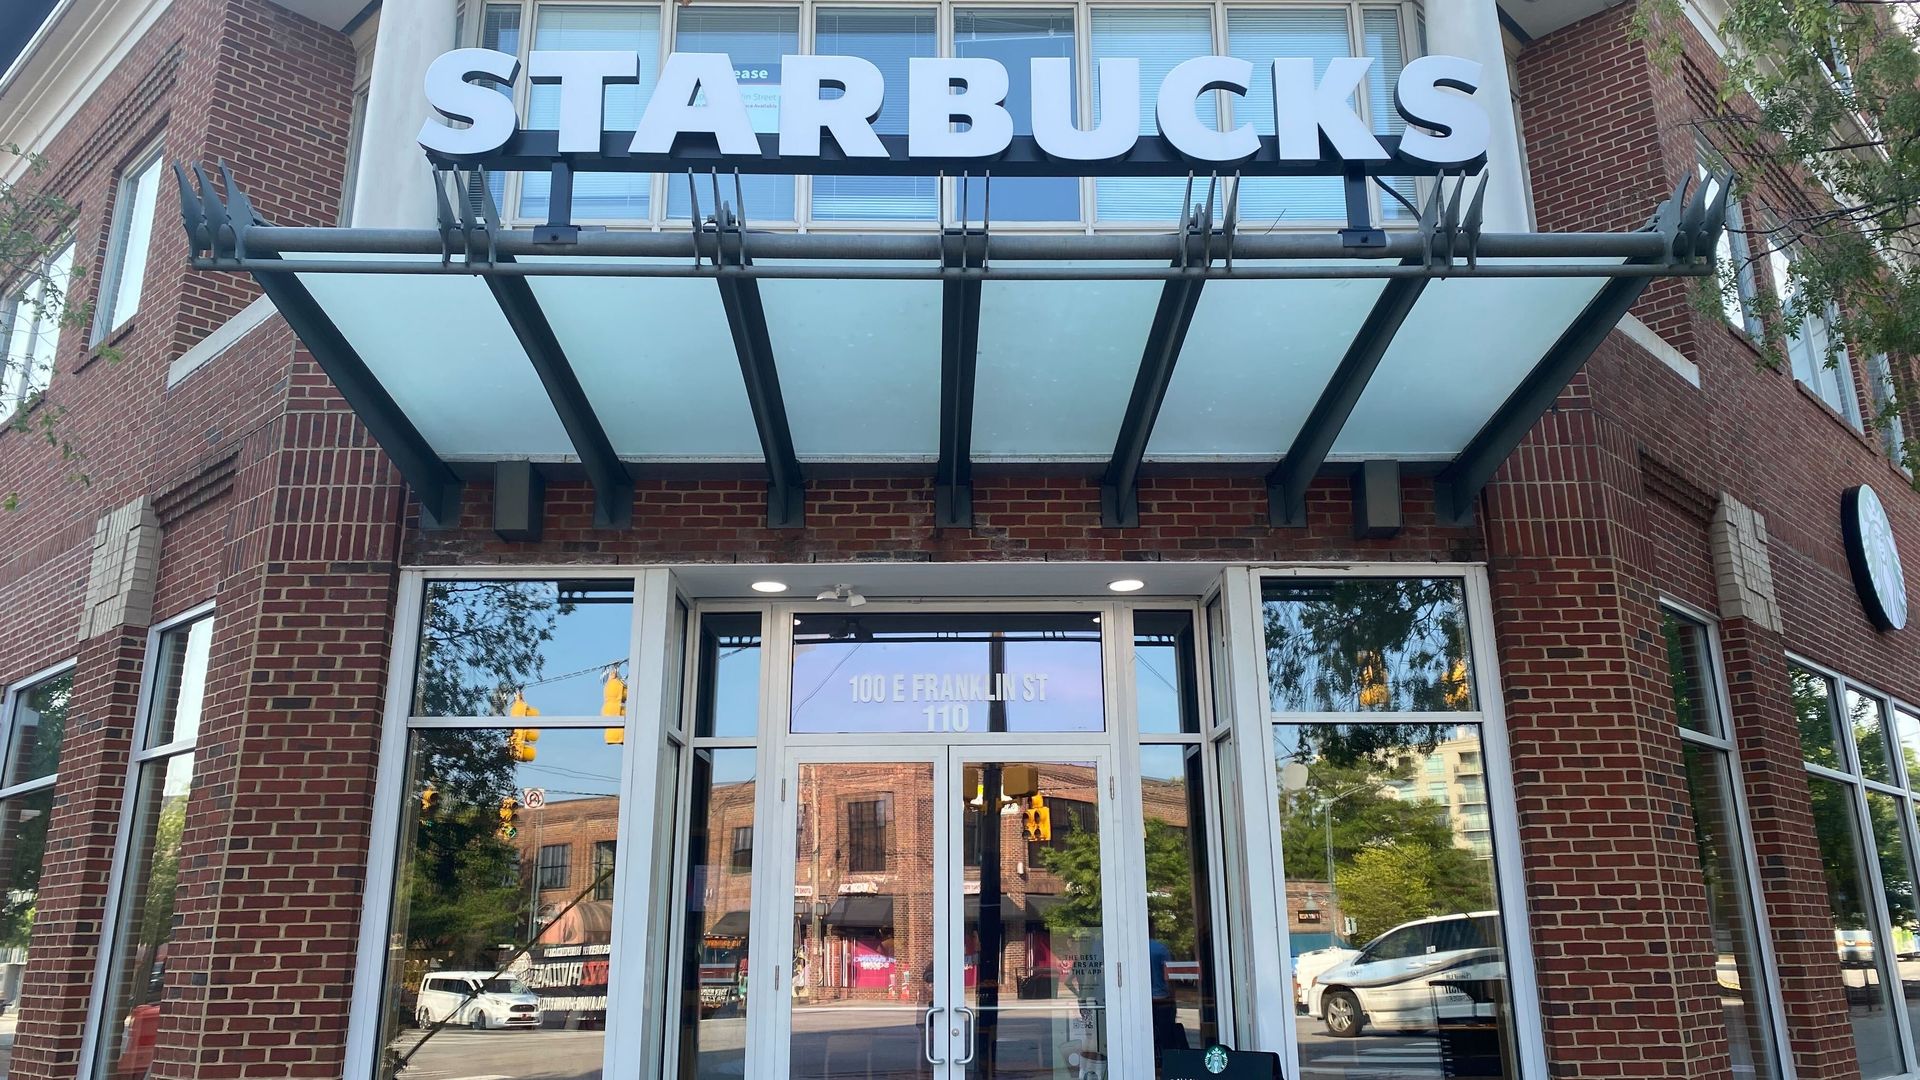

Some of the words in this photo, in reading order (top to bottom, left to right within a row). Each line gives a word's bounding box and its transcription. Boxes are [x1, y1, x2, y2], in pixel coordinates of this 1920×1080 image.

[735, 69, 769, 79] ease
[418, 48, 1490, 164] STARBUCKS
[849, 674, 886, 703] 100
[892, 674, 905, 702] E
[912, 672, 1016, 702] FRANKLIN
[1022, 672, 1049, 702] ST
[922, 704, 969, 733] 110
